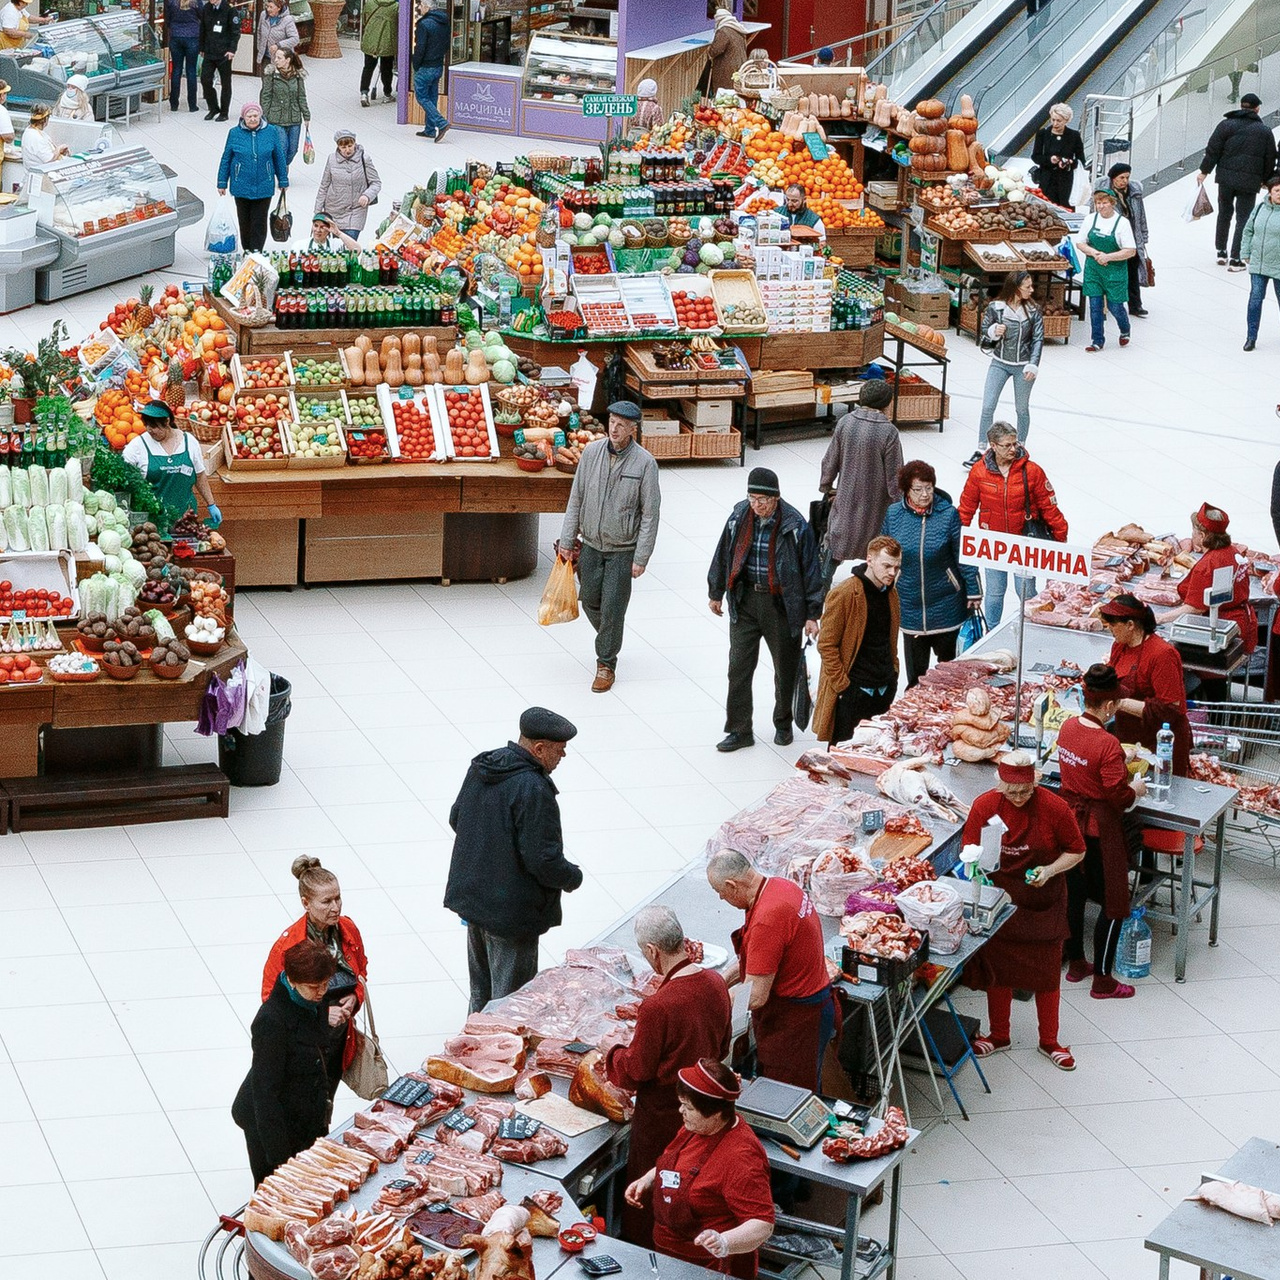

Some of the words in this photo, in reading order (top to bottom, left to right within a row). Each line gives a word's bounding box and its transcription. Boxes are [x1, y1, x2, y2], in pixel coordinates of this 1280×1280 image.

[607, 95, 635, 103] СВЕЖАЯ
[454, 101, 511, 117] МАРЦИПАН
[585, 102, 634, 114] ЗЕЛЕНЬ
[962, 535, 1089, 577] БАРАНИНА
